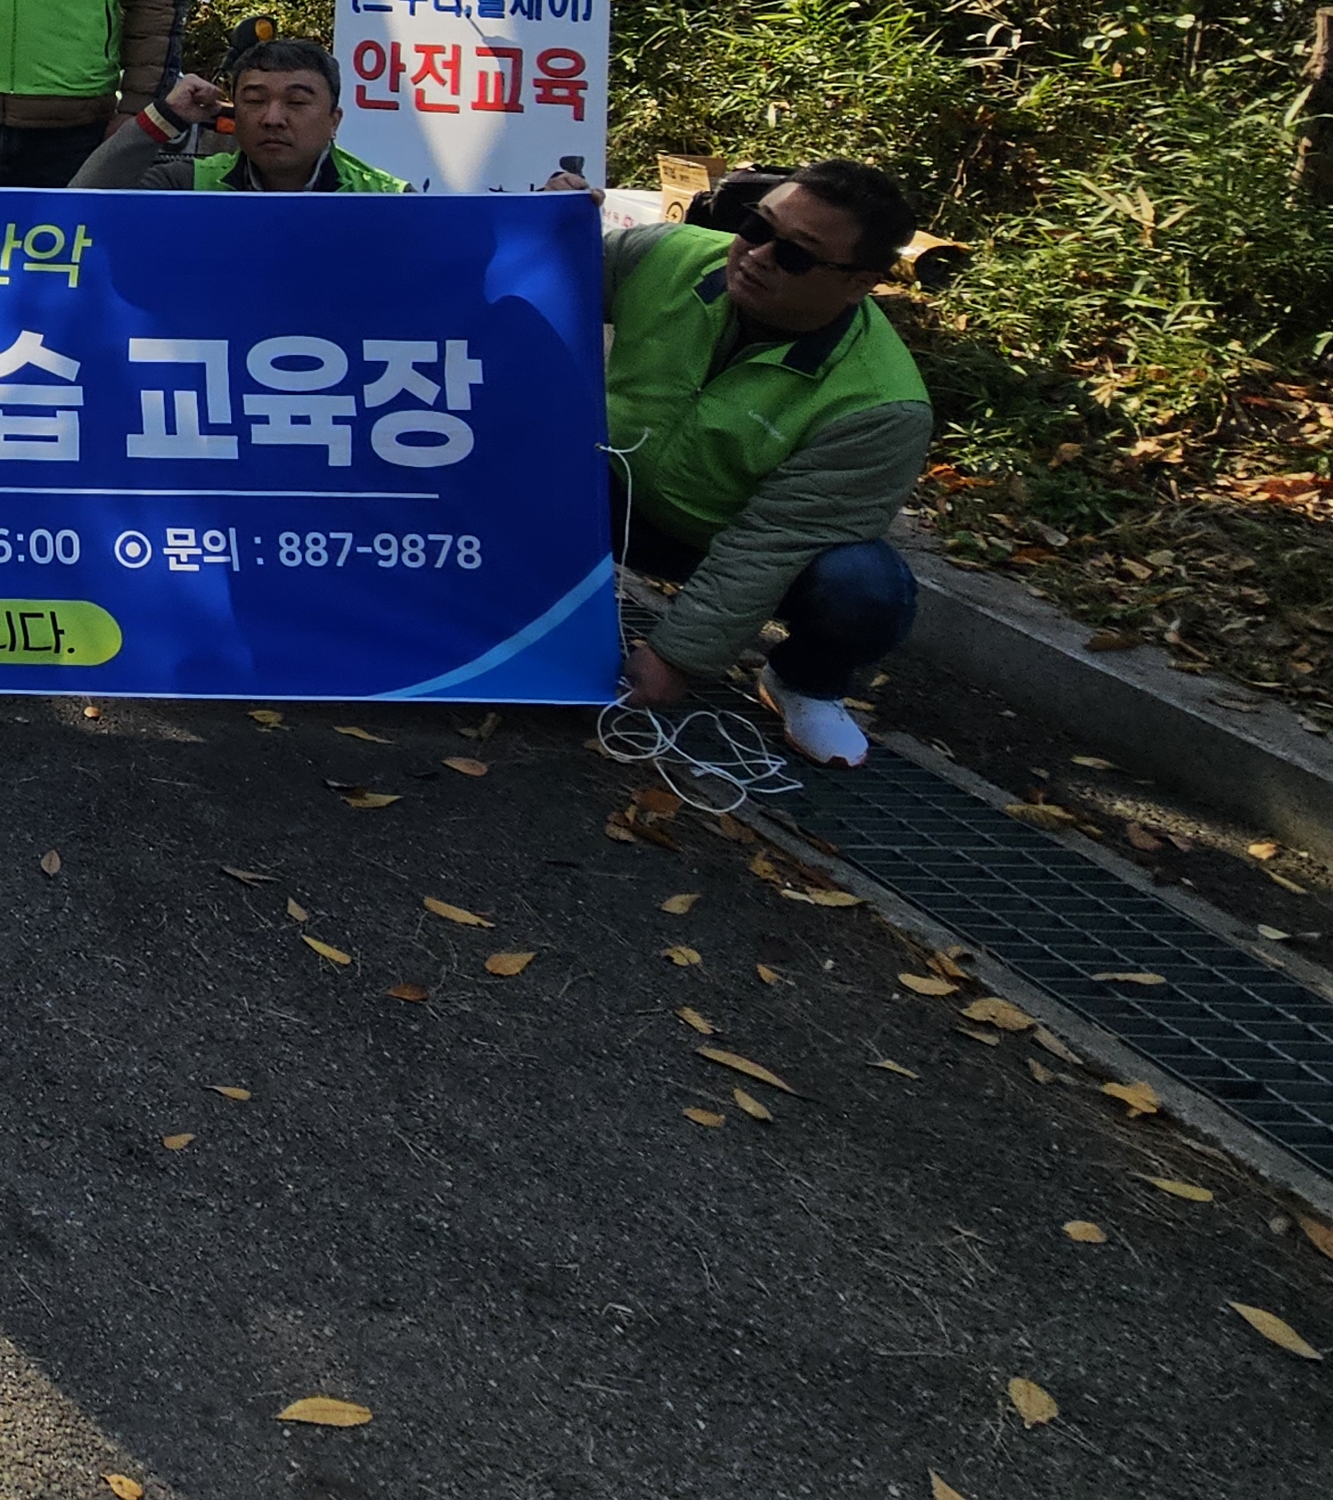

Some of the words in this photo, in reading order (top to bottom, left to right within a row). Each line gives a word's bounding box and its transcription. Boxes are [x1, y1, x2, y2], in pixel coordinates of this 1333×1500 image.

[353, 40, 589, 121] 안전교육
[126, 336, 484, 469] 교육장
[163, 526, 241, 572] 문의
[278, 532, 482, 570] 887-9878
